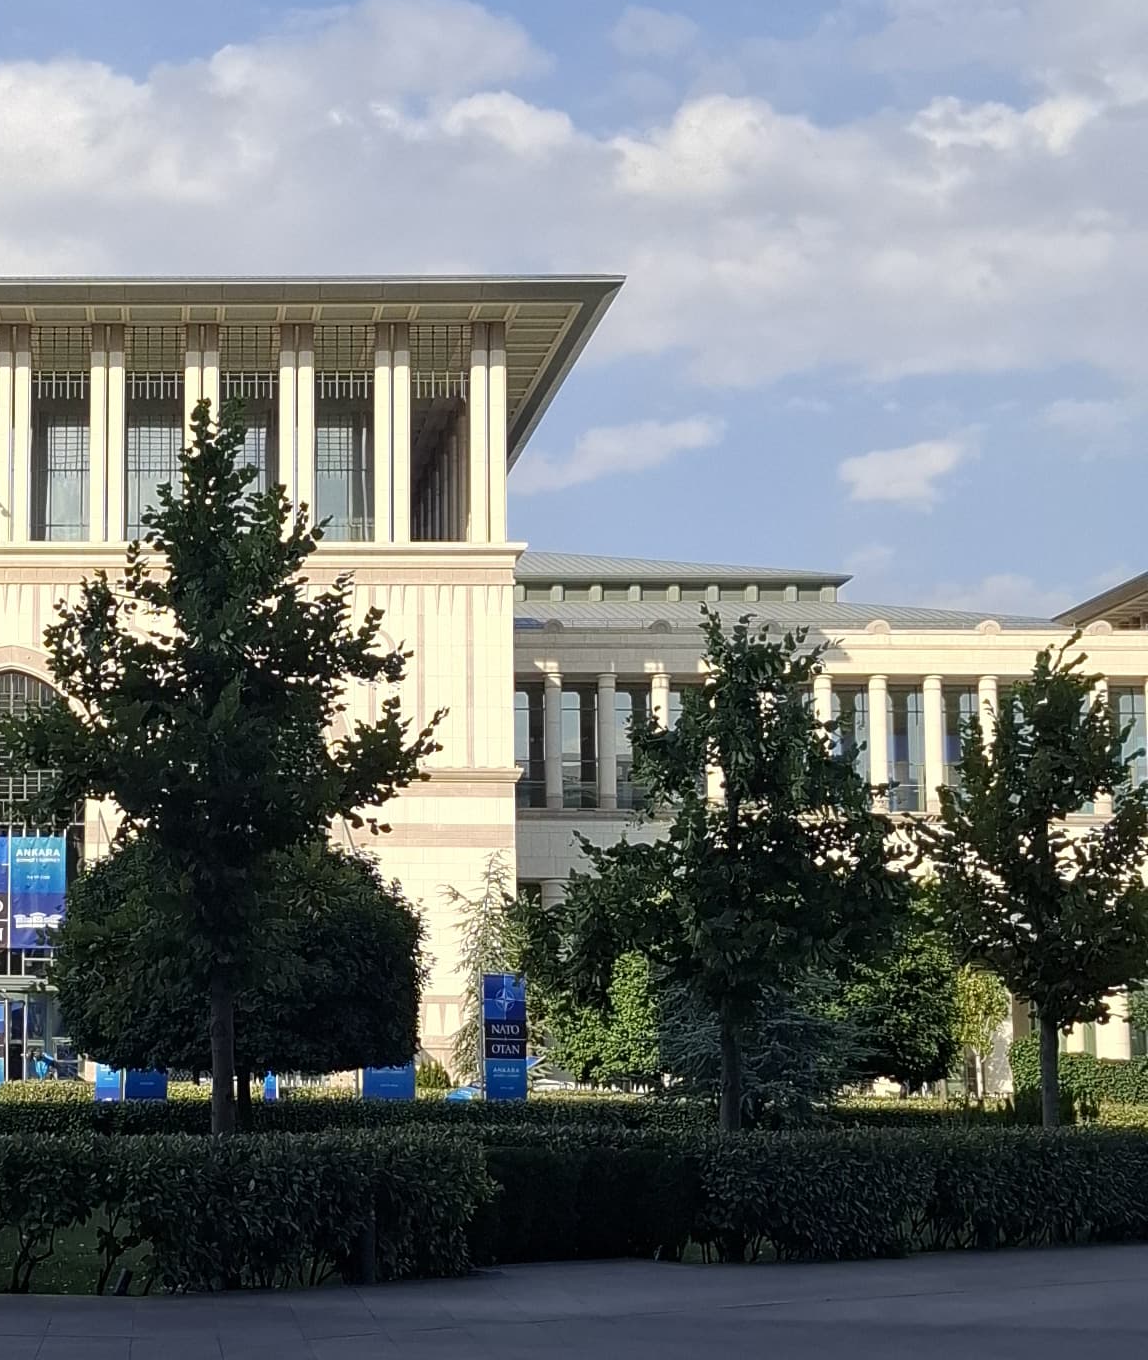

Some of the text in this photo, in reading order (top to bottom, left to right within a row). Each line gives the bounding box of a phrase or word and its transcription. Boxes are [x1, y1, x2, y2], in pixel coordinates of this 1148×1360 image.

[16, 848, 61, 857] ANKARA
[492, 1024, 520, 1035] NATO
[492, 1044, 520, 1054] OTAN
